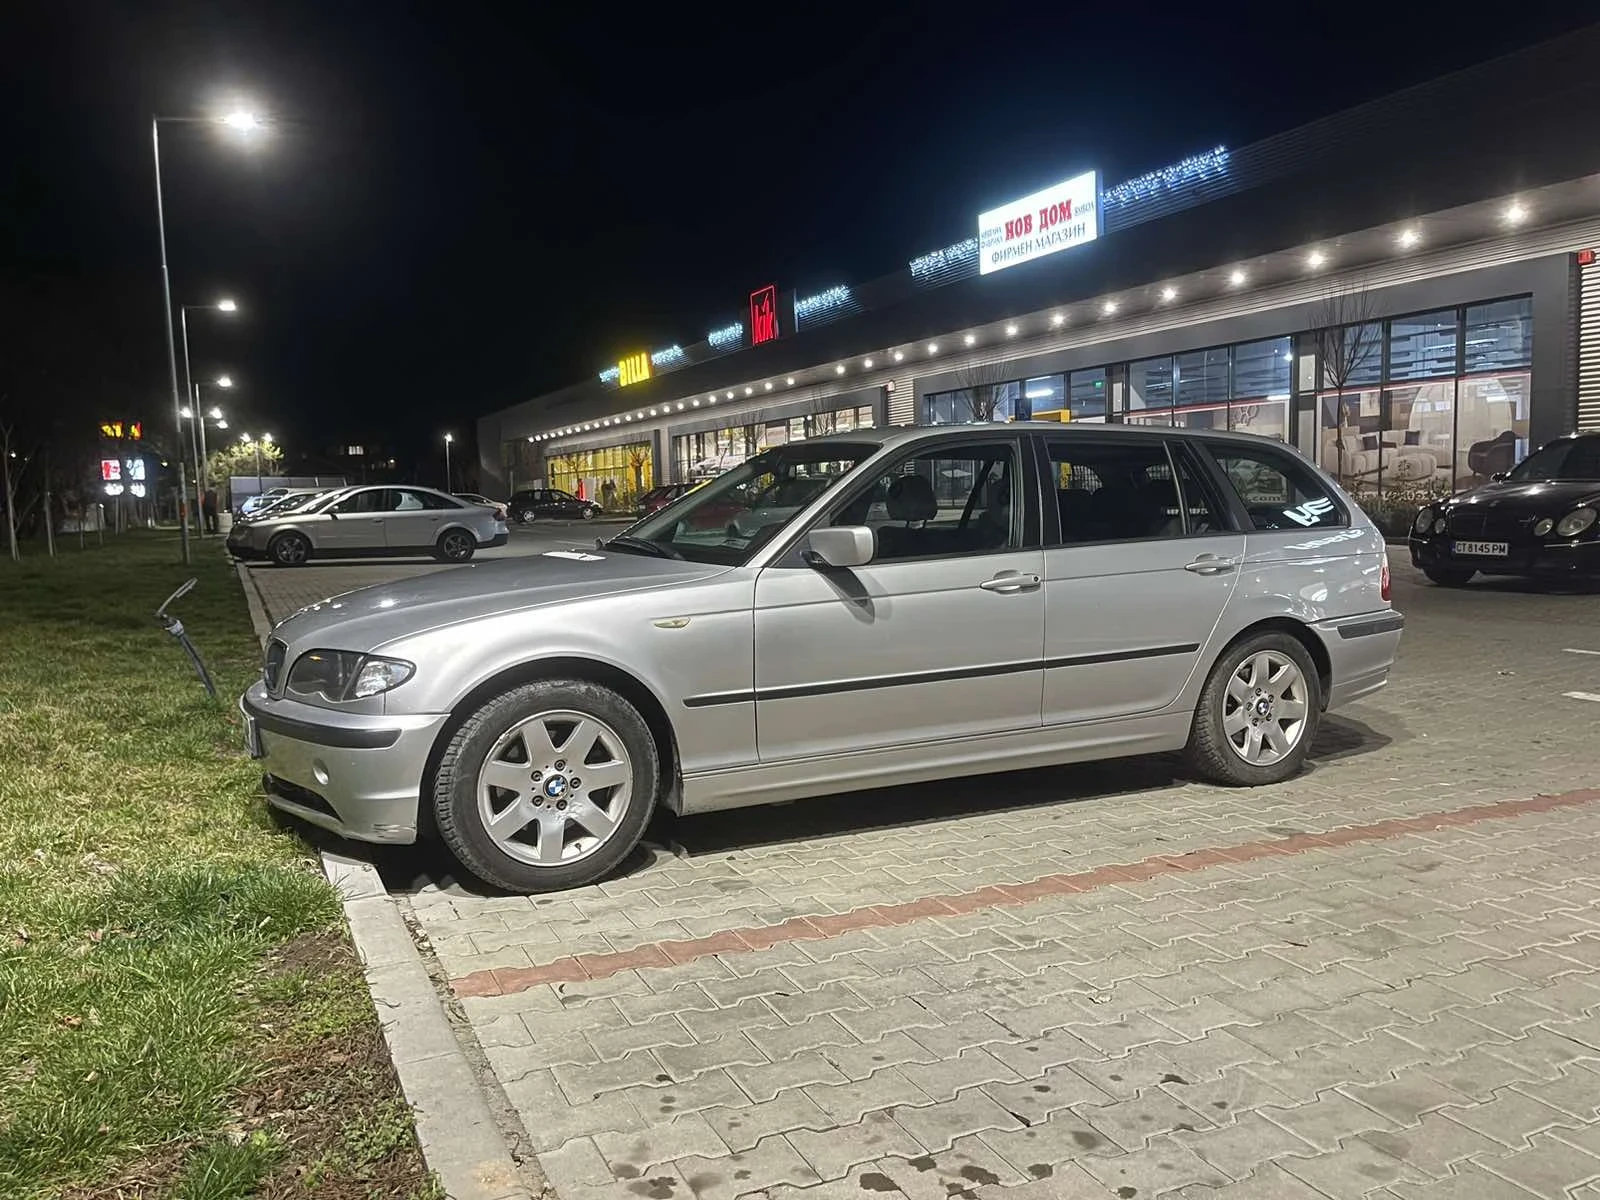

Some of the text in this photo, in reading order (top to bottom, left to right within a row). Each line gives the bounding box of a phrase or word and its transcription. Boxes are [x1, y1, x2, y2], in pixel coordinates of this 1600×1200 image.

[1005, 214, 1033, 241] НОВ
[1039, 199, 1073, 232] ДОМ
[992, 222, 1086, 265] ФИРМЕН МАГАЗИН
[618, 352, 650, 387] BILLA
[1456, 542, 1506, 554] CT 8145 PM
